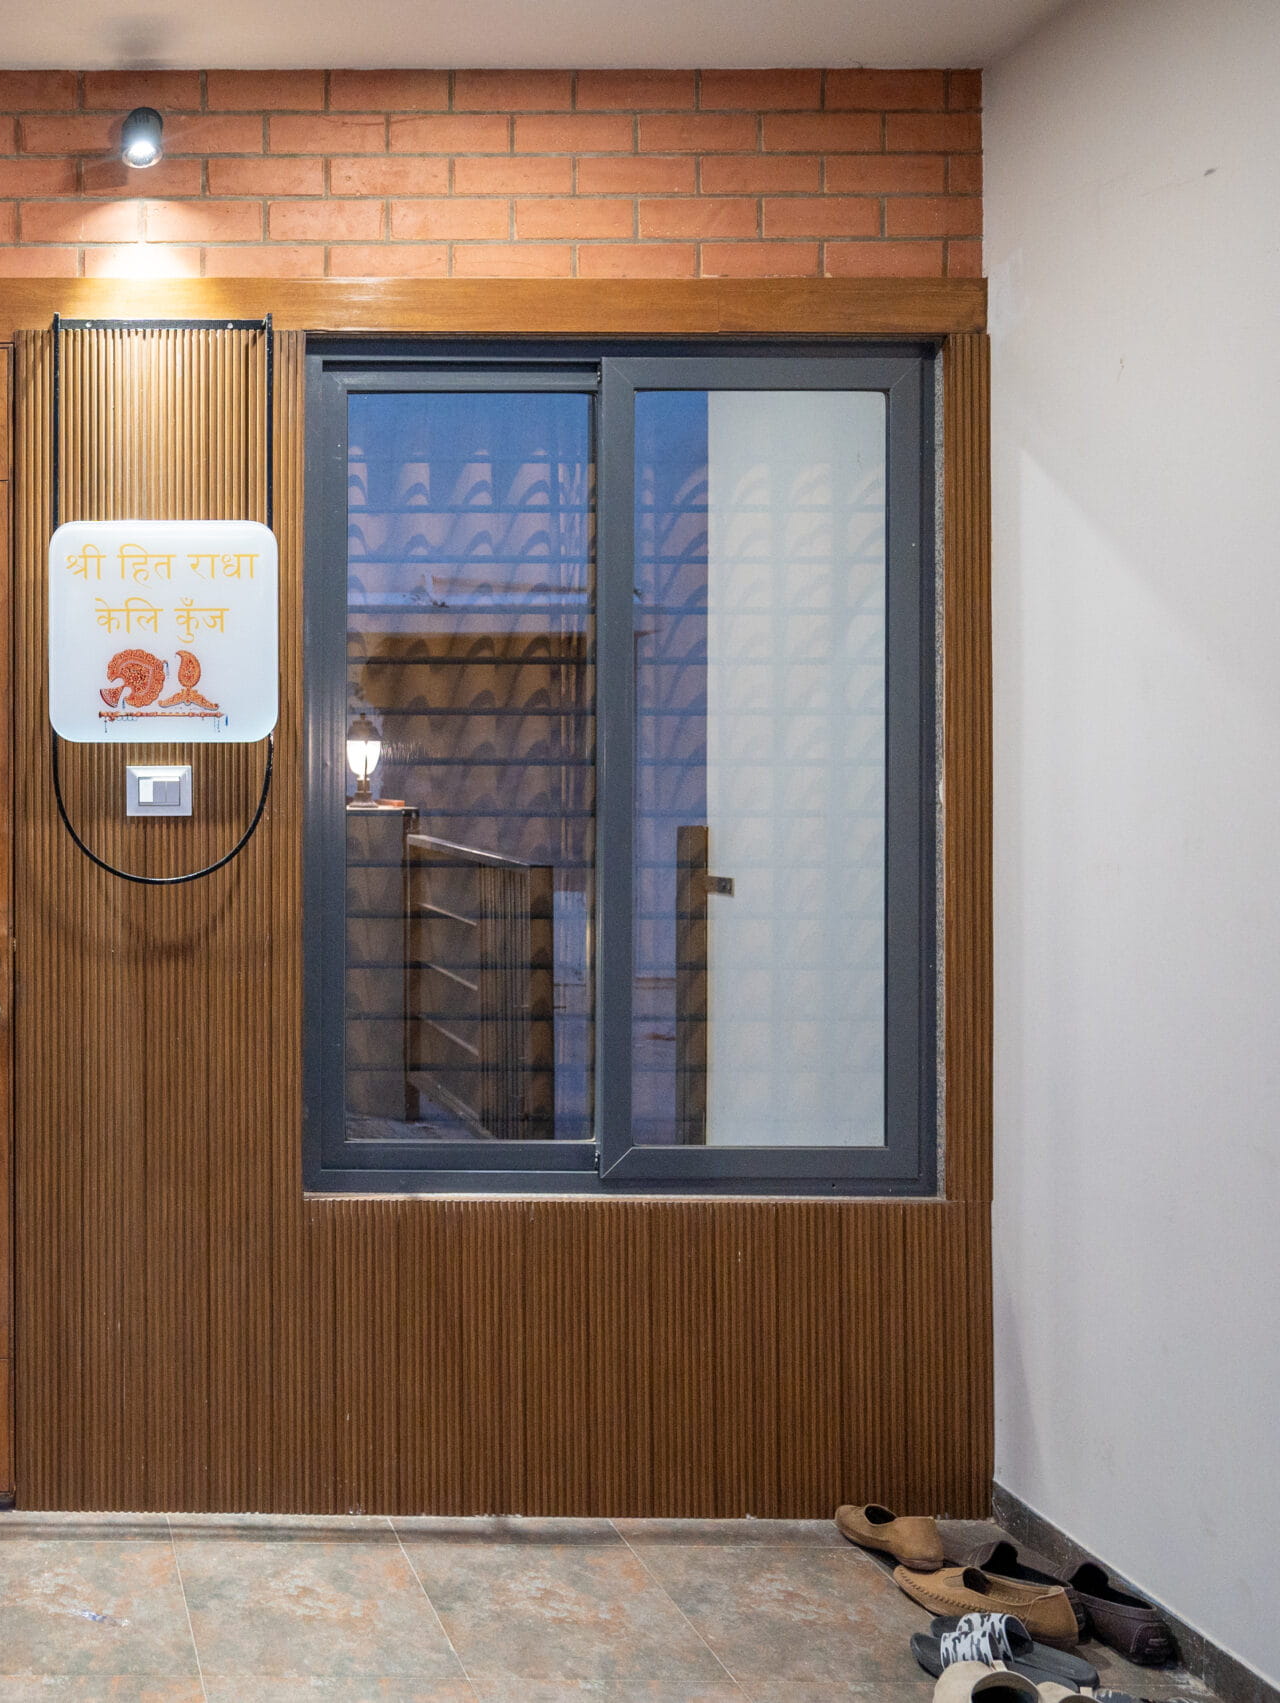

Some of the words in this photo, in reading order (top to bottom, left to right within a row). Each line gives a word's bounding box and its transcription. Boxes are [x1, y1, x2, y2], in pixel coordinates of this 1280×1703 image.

[65, 543, 106, 580] श्री
[117, 543, 176, 589] हित
[187, 553, 260, 580] राधा
[95, 597, 163, 634] केलि
[174, 597, 230, 644] कुँज
